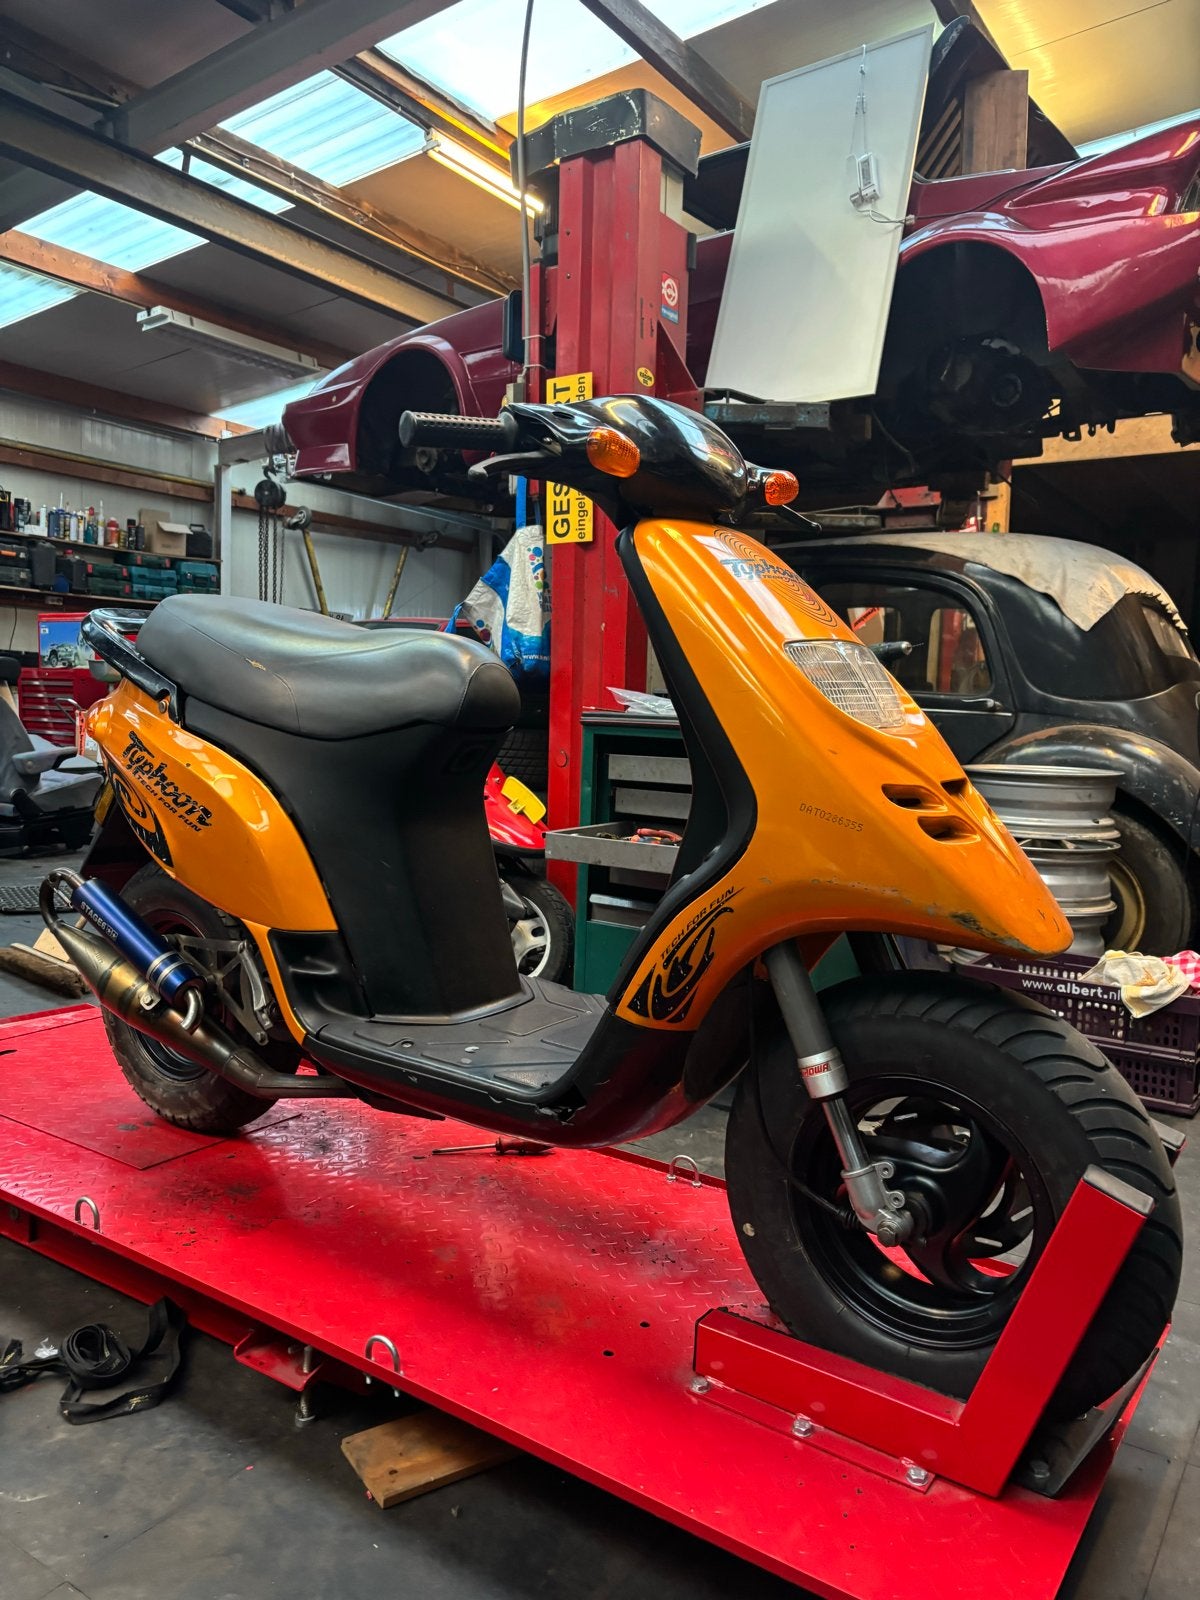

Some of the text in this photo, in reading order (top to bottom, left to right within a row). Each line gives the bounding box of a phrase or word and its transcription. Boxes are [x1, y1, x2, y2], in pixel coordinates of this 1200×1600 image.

[123, 730, 212, 827] Typhoon
[137, 776, 202, 832] TECH FOR FUN
[660, 886, 735, 960] TECH FOR FUN
[1022, 980, 1121, 1001] www.albert.nl
